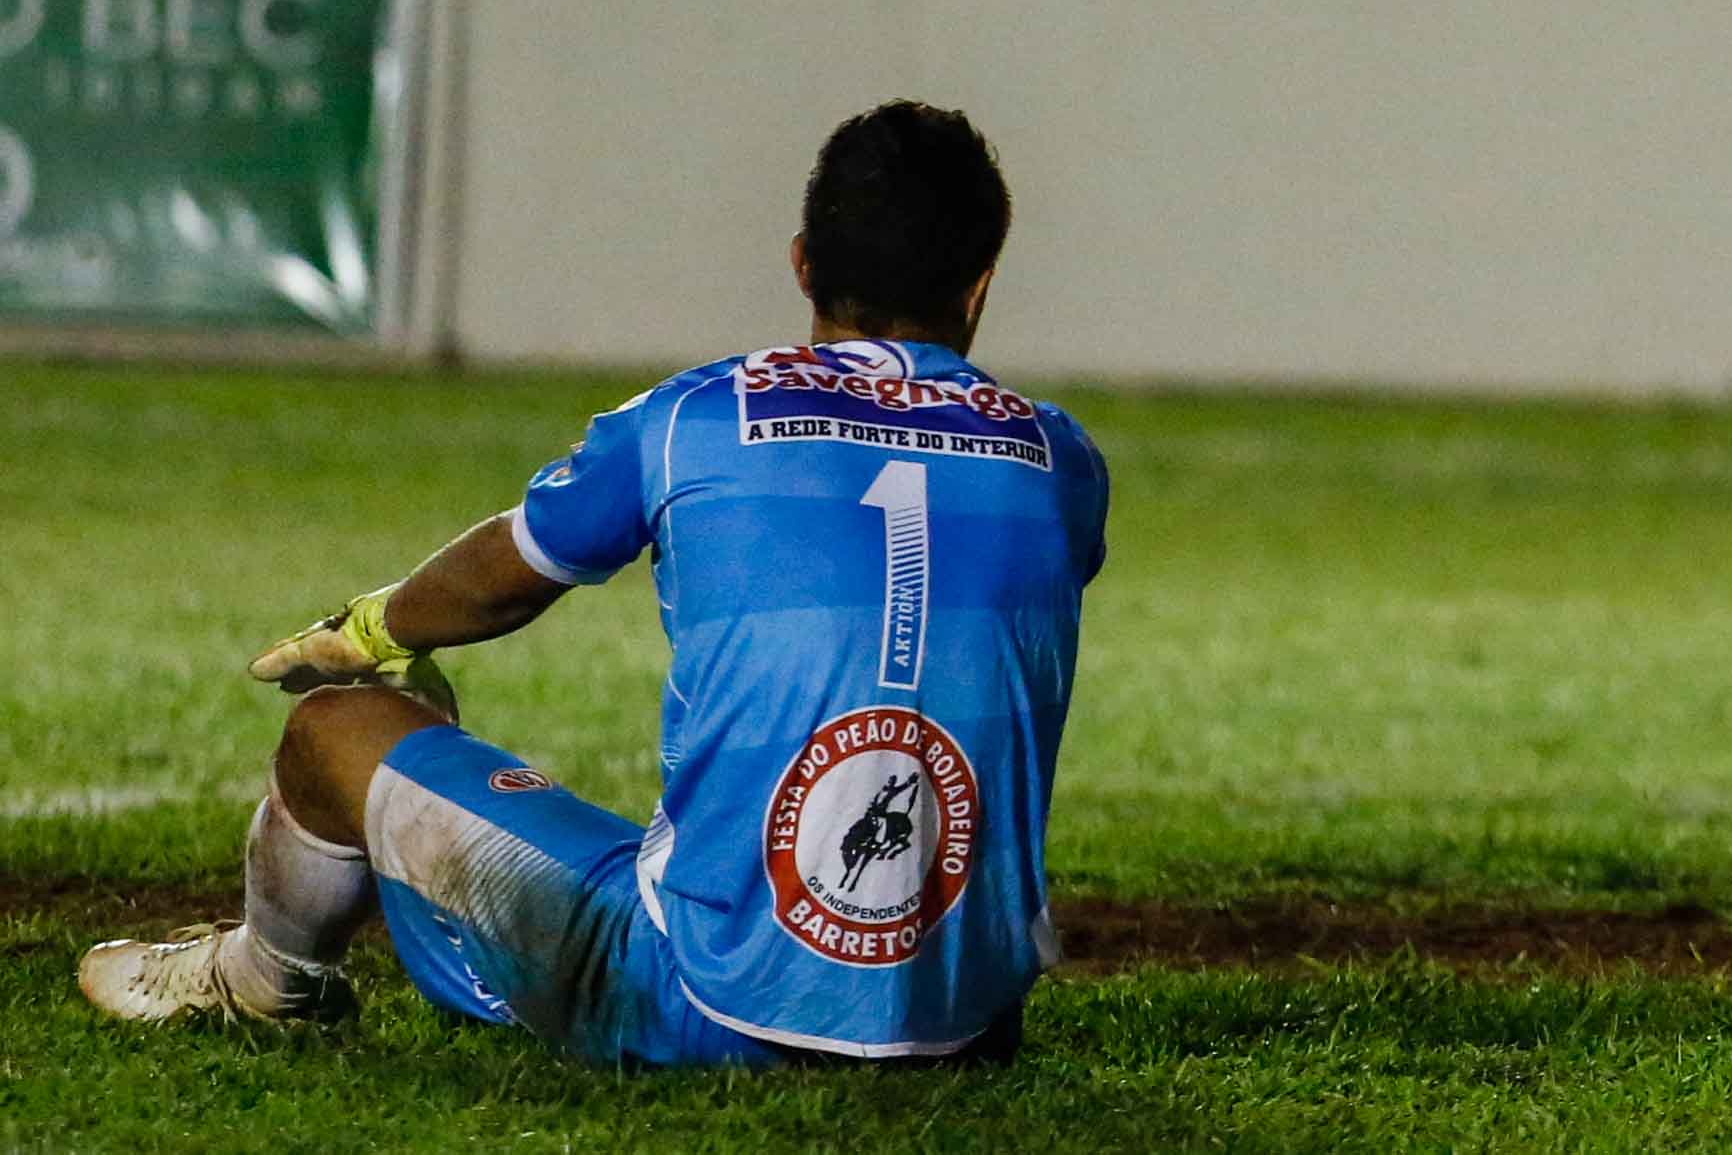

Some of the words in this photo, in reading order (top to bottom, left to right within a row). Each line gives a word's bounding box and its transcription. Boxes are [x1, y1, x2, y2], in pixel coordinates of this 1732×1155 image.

[748, 423, 764, 441] A
[771, 419, 832, 438] REDE
[838, 421, 910, 447] FORTE
[916, 432, 944, 450] DO
[950, 435, 1049, 469] INTERIOR
[860, 459, 928, 691] 1
[834, 712, 896, 754] PEÃO
[925, 741, 974, 875] BOIADEIRO
[807, 876, 824, 894] OS
